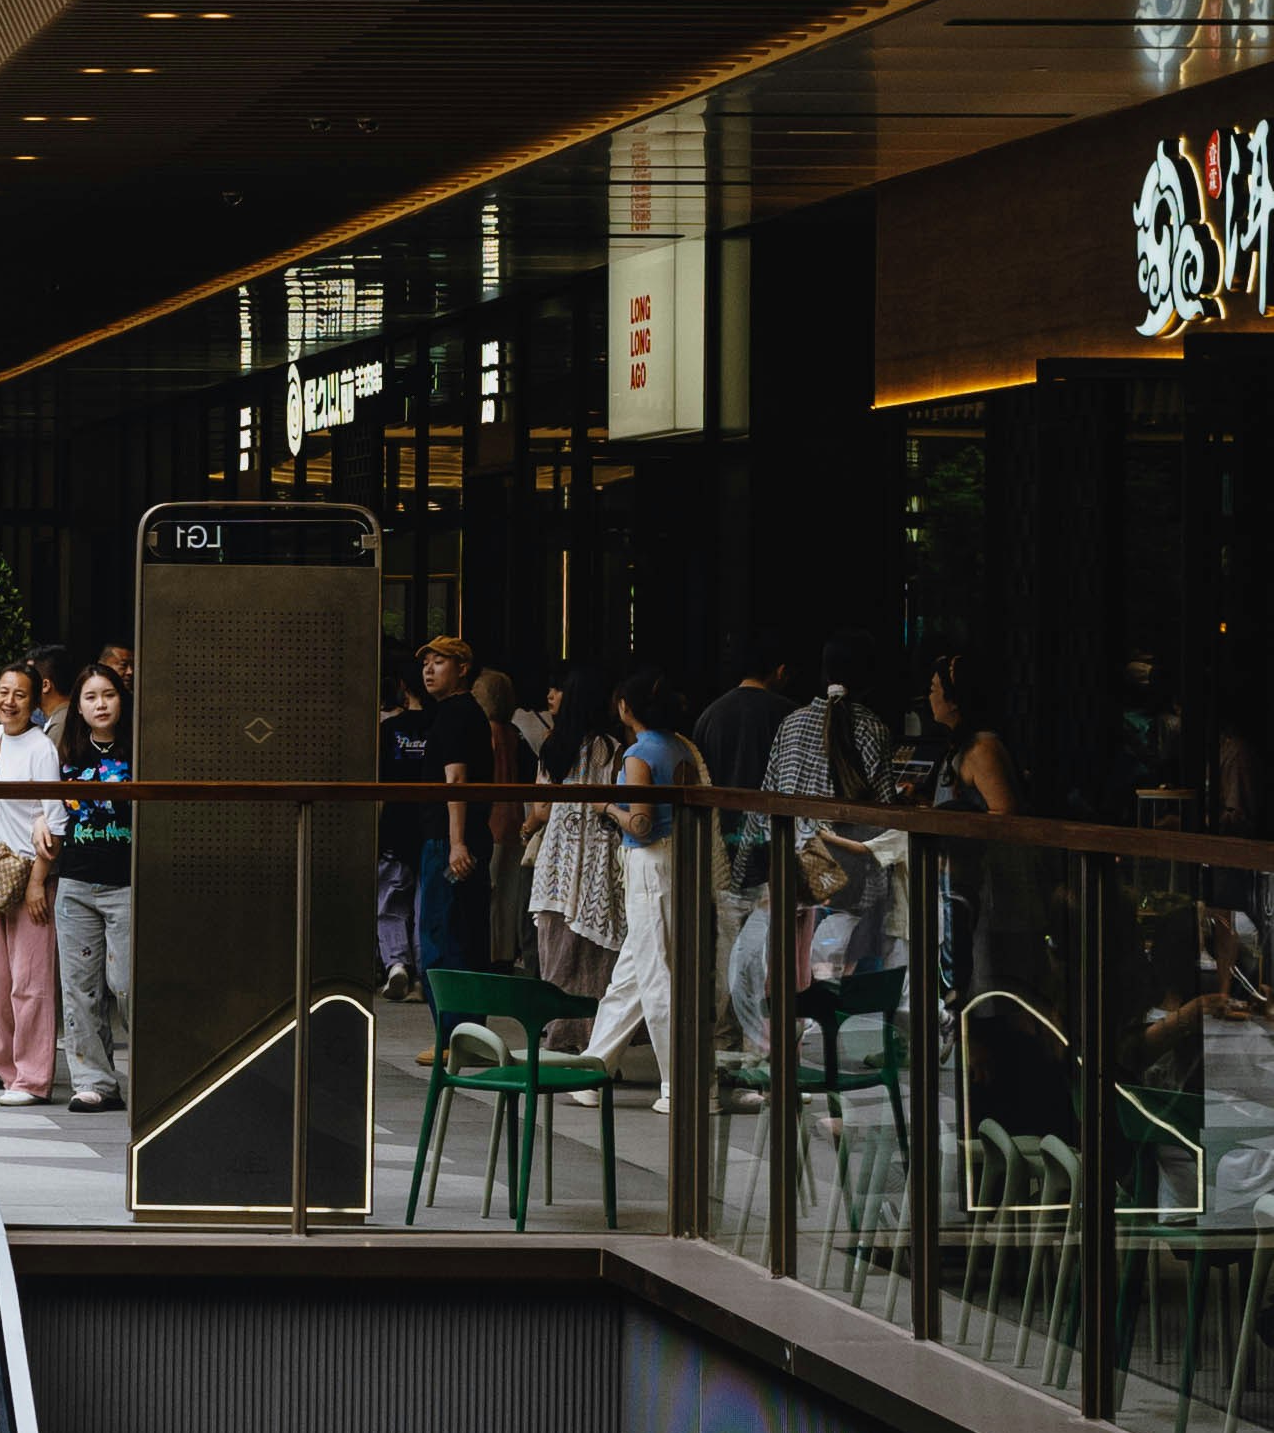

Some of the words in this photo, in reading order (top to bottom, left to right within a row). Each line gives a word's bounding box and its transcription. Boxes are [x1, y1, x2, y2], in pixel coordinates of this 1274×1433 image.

[630, 294, 651, 325] LONG
[630, 327, 651, 358] LONG
[630, 361, 647, 391] AGO
